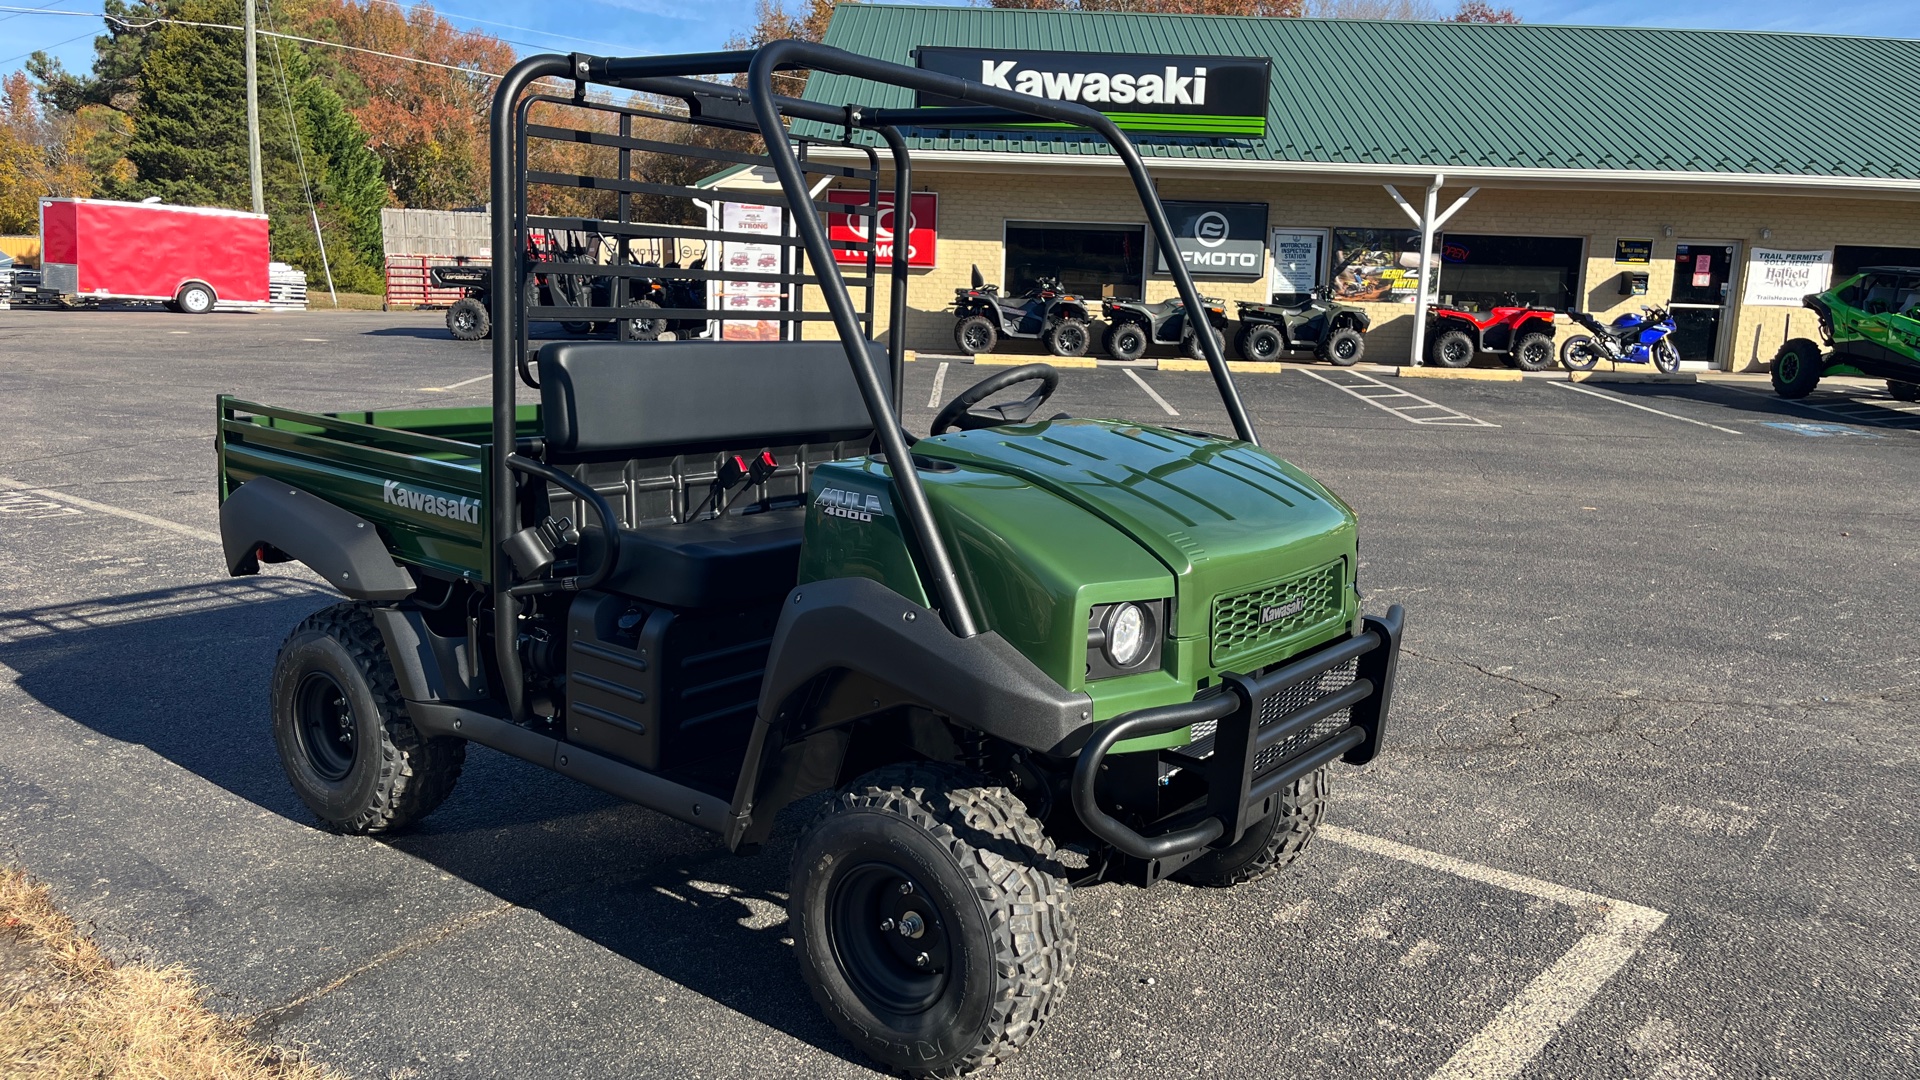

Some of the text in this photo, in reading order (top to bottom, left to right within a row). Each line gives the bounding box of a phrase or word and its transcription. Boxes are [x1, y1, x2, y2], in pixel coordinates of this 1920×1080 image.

[981, 59, 1206, 106] Kawasaki
[738, 222, 769, 230] STRONG
[1759, 252, 1824, 261] TRAIL PERMITS
[1381, 268, 1406, 279] READY
[1765, 266, 1810, 281] Hatfield
[383, 479, 481, 525] Kawasaki
[813, 487, 885, 516] MULE
[823, 506, 872, 522] 4000
[1261, 596, 1305, 624] Kawasaki
